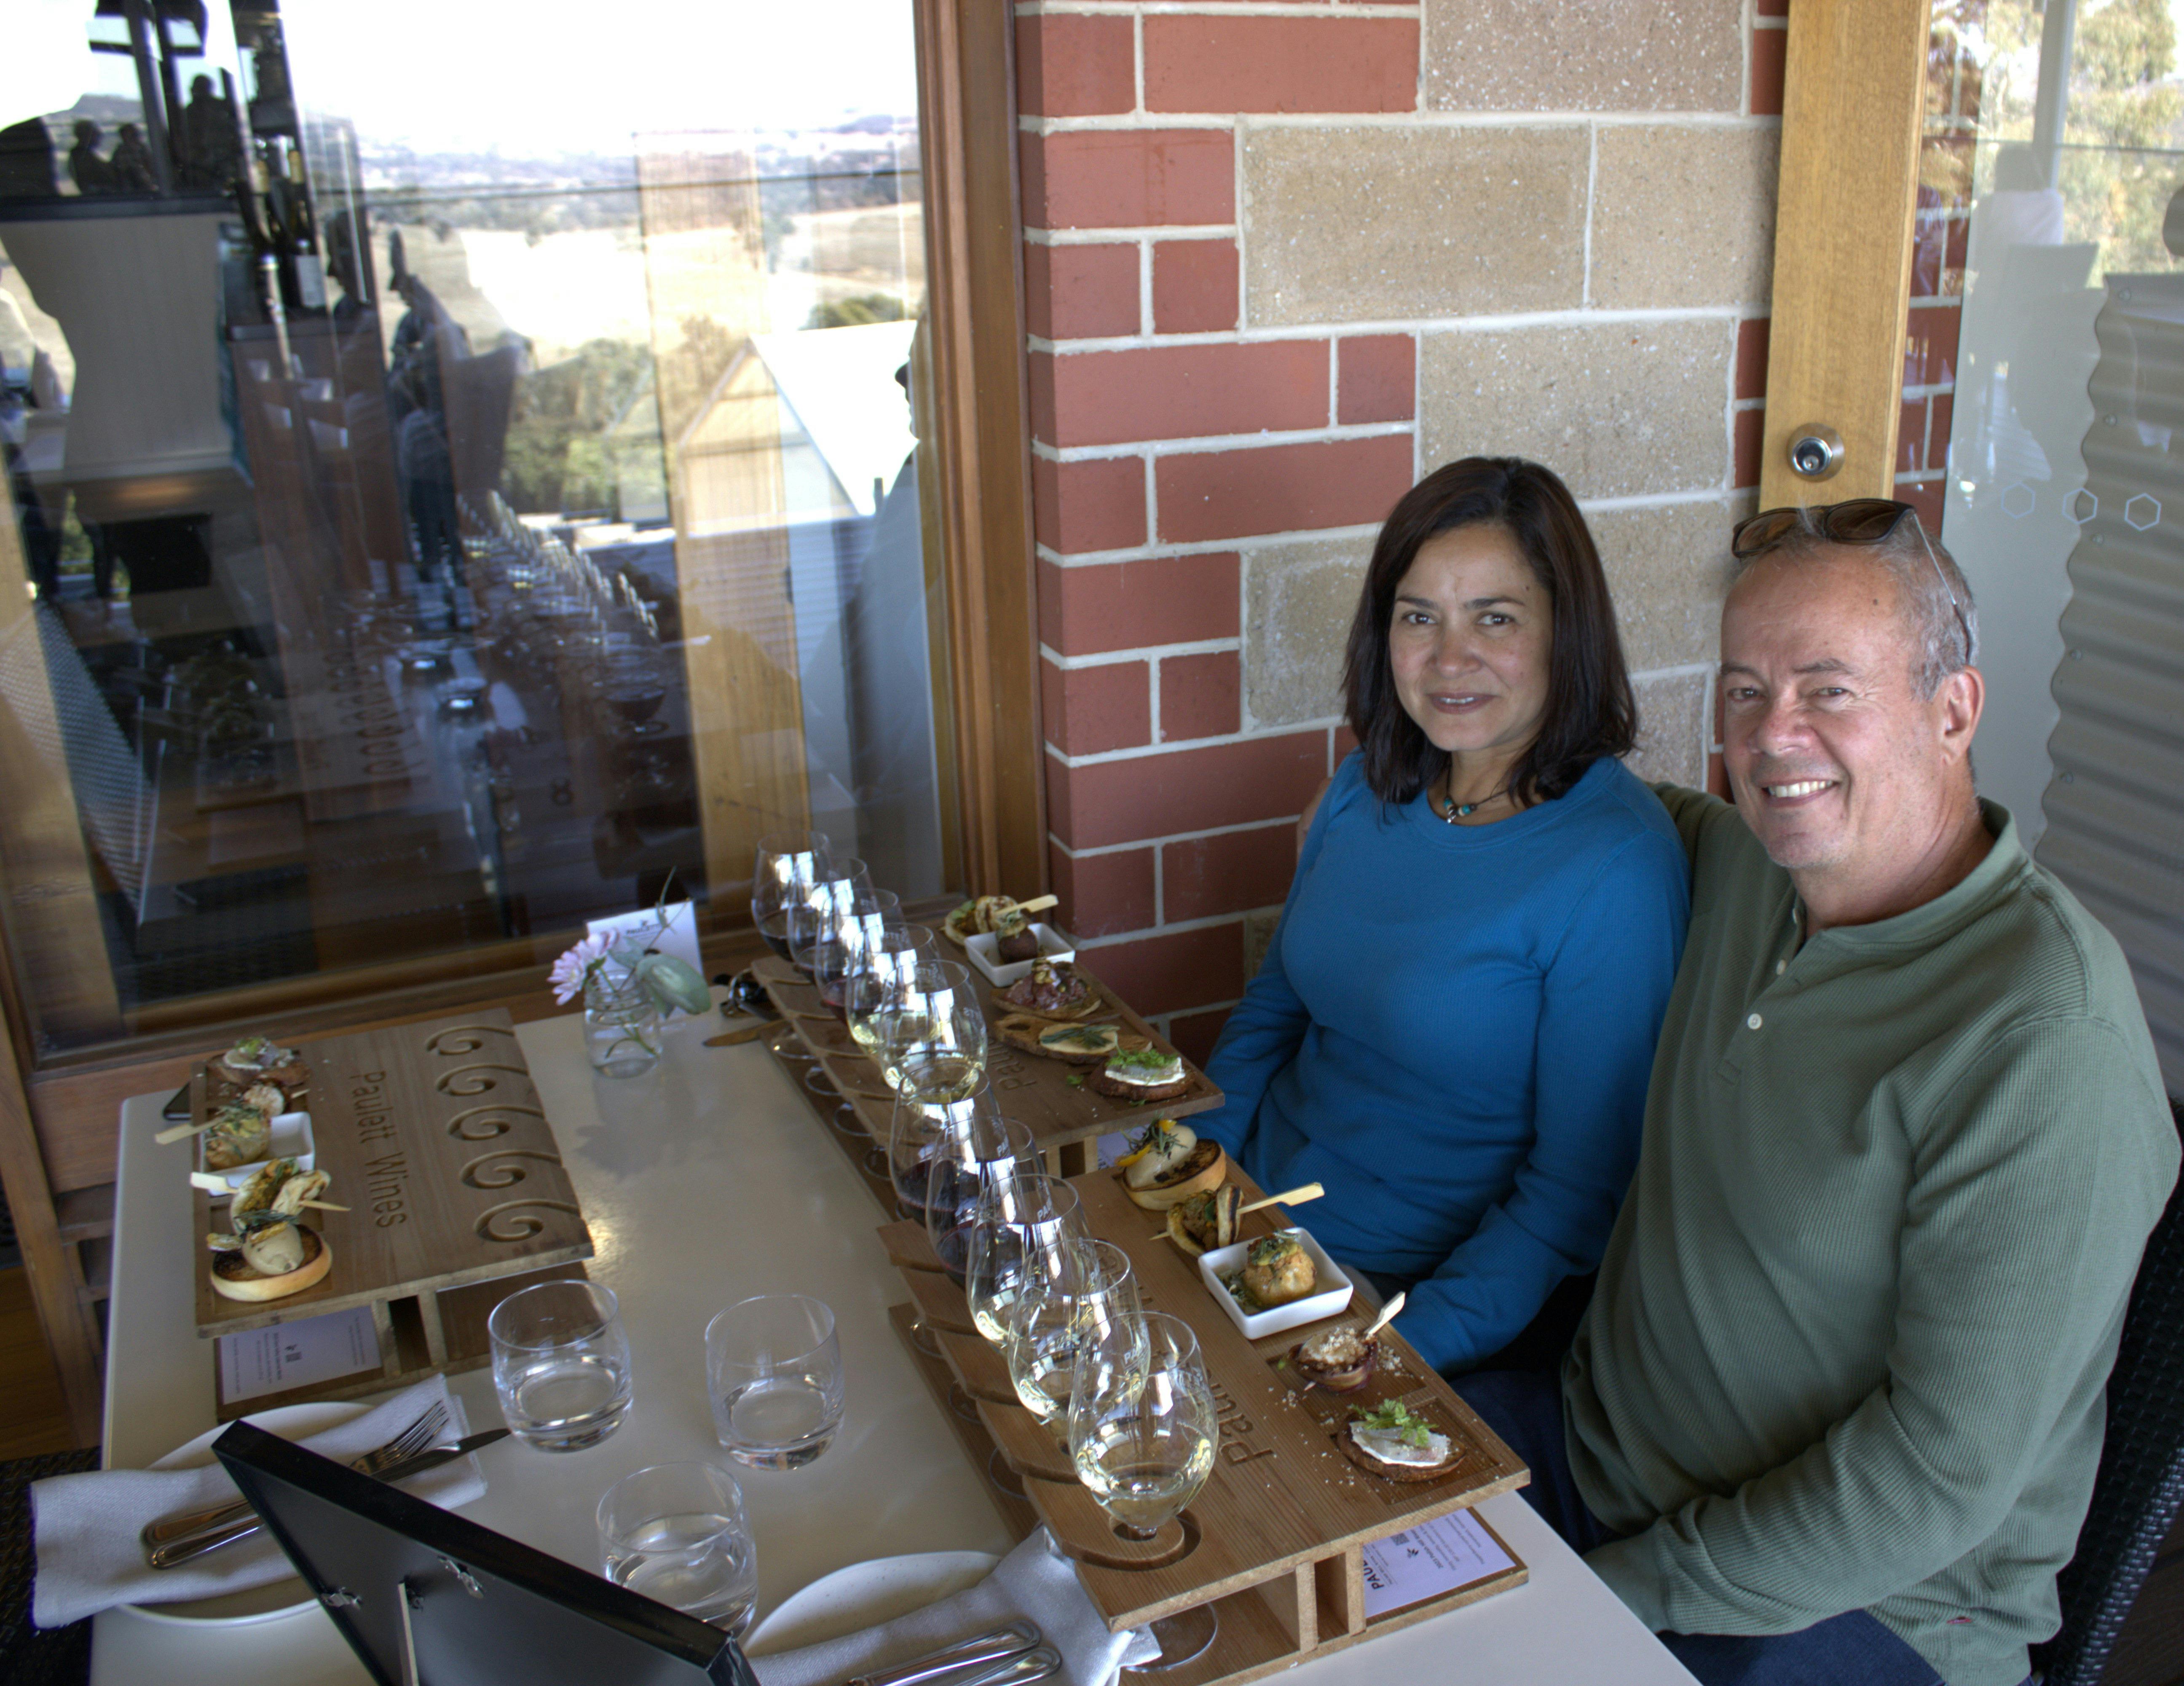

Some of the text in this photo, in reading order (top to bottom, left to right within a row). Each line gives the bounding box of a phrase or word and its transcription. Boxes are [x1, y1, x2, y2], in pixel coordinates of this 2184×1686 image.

[987, 1040, 1037, 1091] Paul
[349, 1071, 409, 1228] Paulett Wines
